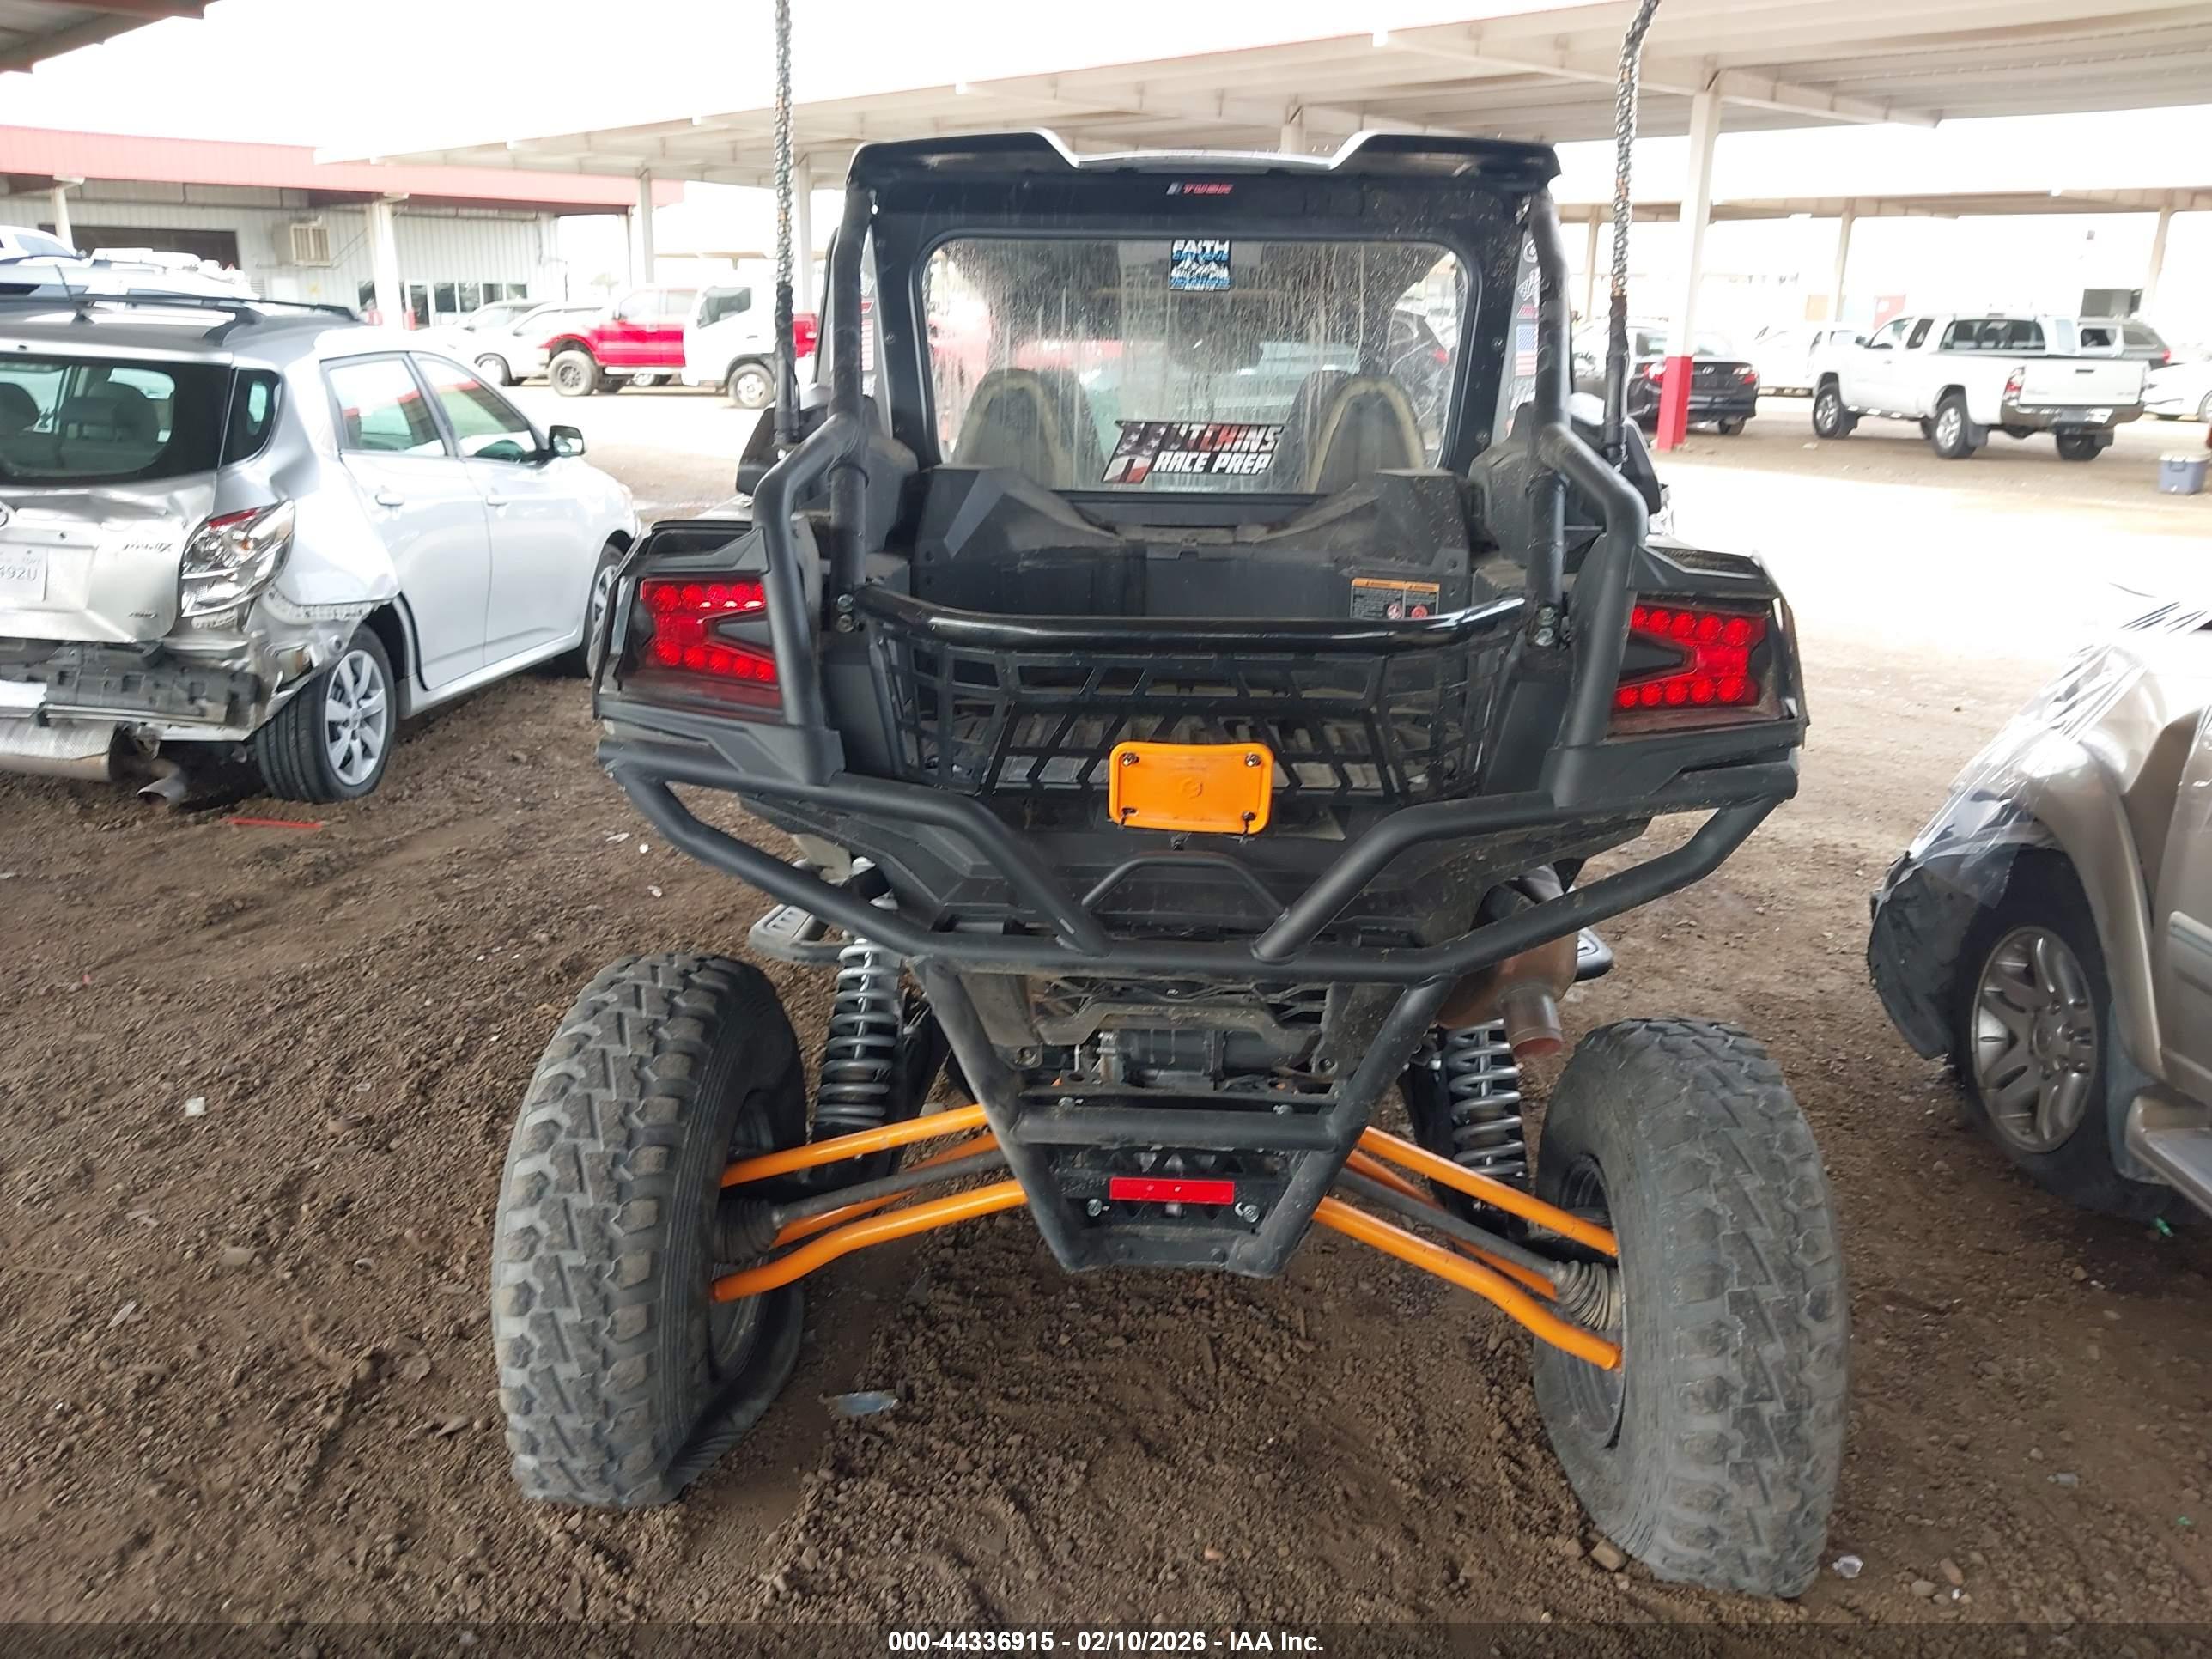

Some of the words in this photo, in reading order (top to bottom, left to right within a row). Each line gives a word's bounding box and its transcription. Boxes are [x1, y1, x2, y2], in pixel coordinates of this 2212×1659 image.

[1173, 240, 1229, 255] FAITH
[1152, 451, 1211, 473] RACE
[1211, 452, 1273, 475] PREP
